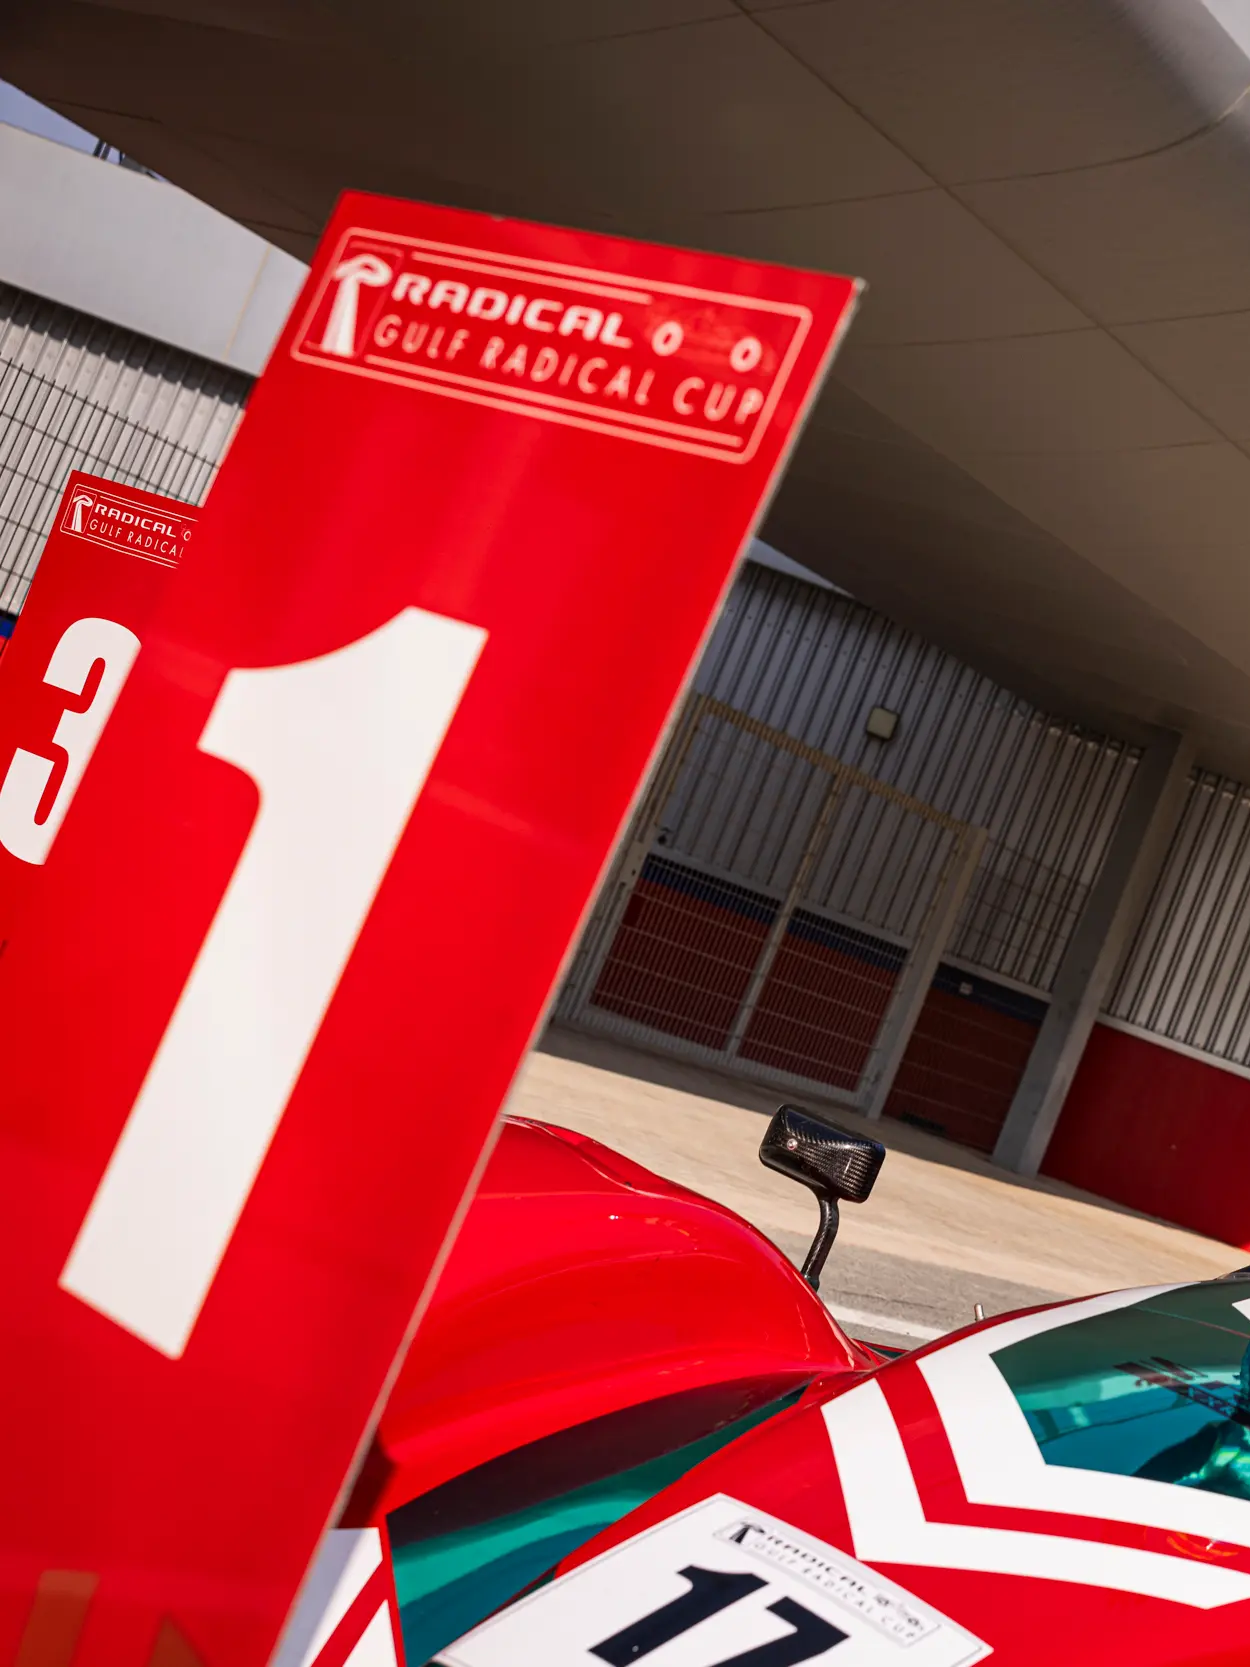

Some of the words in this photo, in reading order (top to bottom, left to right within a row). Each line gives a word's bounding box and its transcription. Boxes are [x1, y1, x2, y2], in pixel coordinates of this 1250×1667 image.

[390, 271, 634, 350] RADICAL
[373, 313, 470, 362] GULF
[479, 335, 656, 406] RADICAL
[672, 375, 765, 425] CUP
[89, 519, 123, 539] GULF
[94, 503, 177, 538] RADICAL
[0, 617, 141, 866] 3
[58, 606, 489, 1360] 1
[766, 1534, 867, 1592] RADICAL
[587, 1564, 851, 1667] 17
